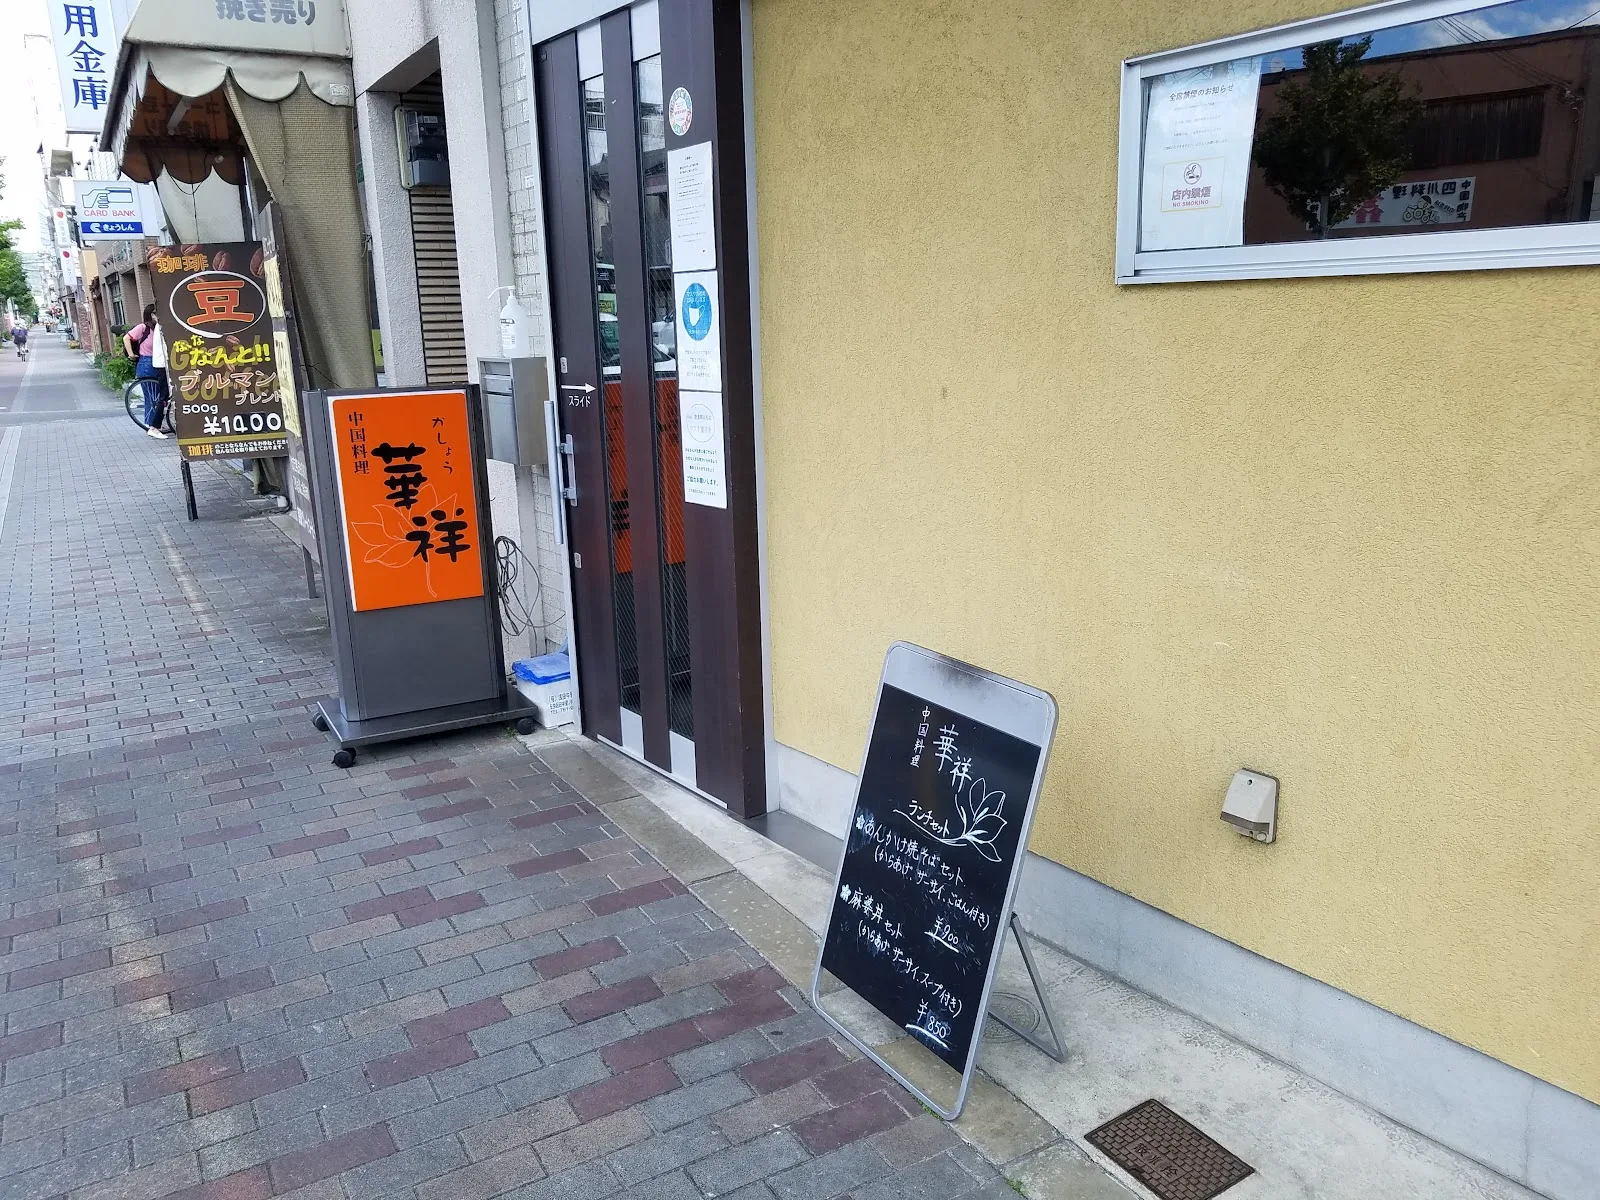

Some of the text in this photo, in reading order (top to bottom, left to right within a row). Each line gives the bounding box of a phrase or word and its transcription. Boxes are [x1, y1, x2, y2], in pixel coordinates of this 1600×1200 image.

[63, 3, 109, 110] 用金庫
[84, 209, 136, 217] CARD BANK
[1182, 199, 1209, 207] SMOKING
[102, 223, 135, 232] きょうしん
[187, 280, 255, 326] 豆
[178, 368, 277, 392] ブルマン
[182, 404, 219, 414] 500g
[568, 395, 591, 408] スライド
[203, 412, 282, 436] ¥1400
[348, 411, 370, 475] 中国料理
[431, 416, 454, 476] かしょう
[371, 442, 471, 563] 華祥
[909, 705, 931, 768] 中国料理
[932, 723, 973, 794] 華祥
[908, 799, 951, 838] ランチセット
